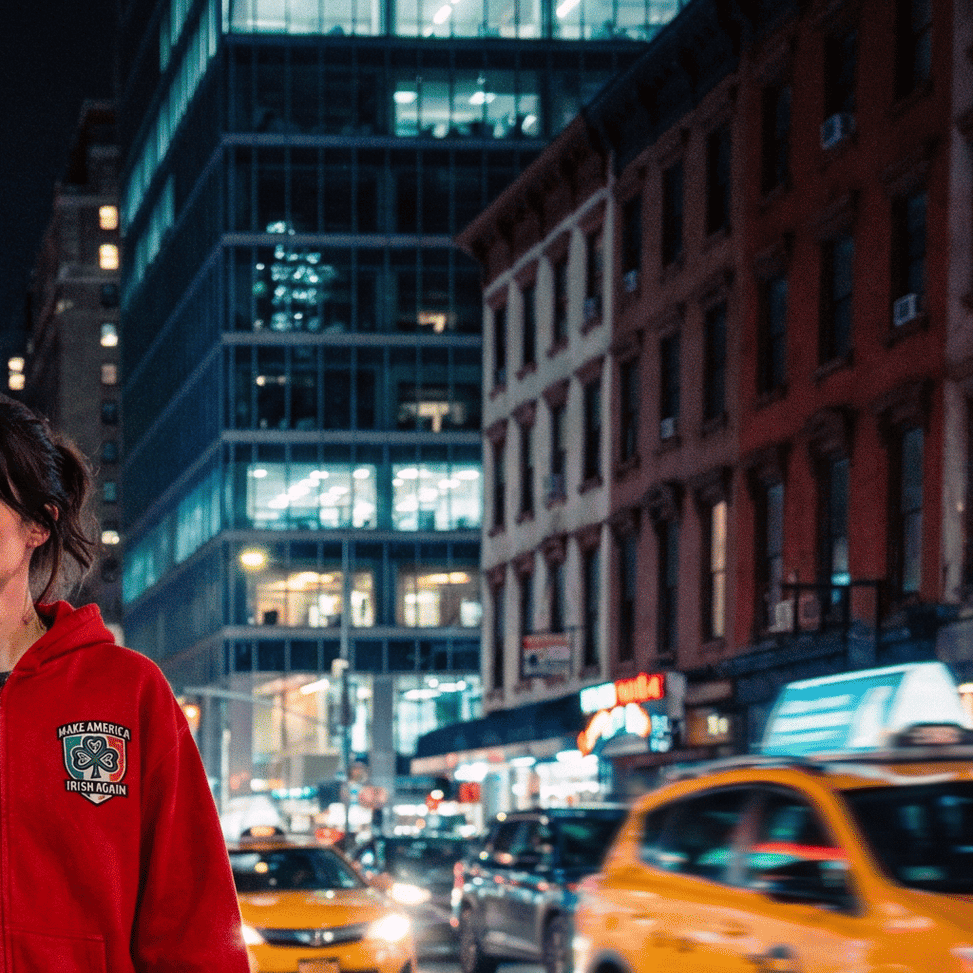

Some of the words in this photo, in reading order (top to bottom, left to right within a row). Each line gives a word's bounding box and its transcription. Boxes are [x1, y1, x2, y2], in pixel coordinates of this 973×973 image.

[58, 722, 85, 738] MAKE
[86, 722, 131, 740] AMERICA
[66, 780, 94, 792] IRISH
[95, 782, 127, 796] AGAIN
